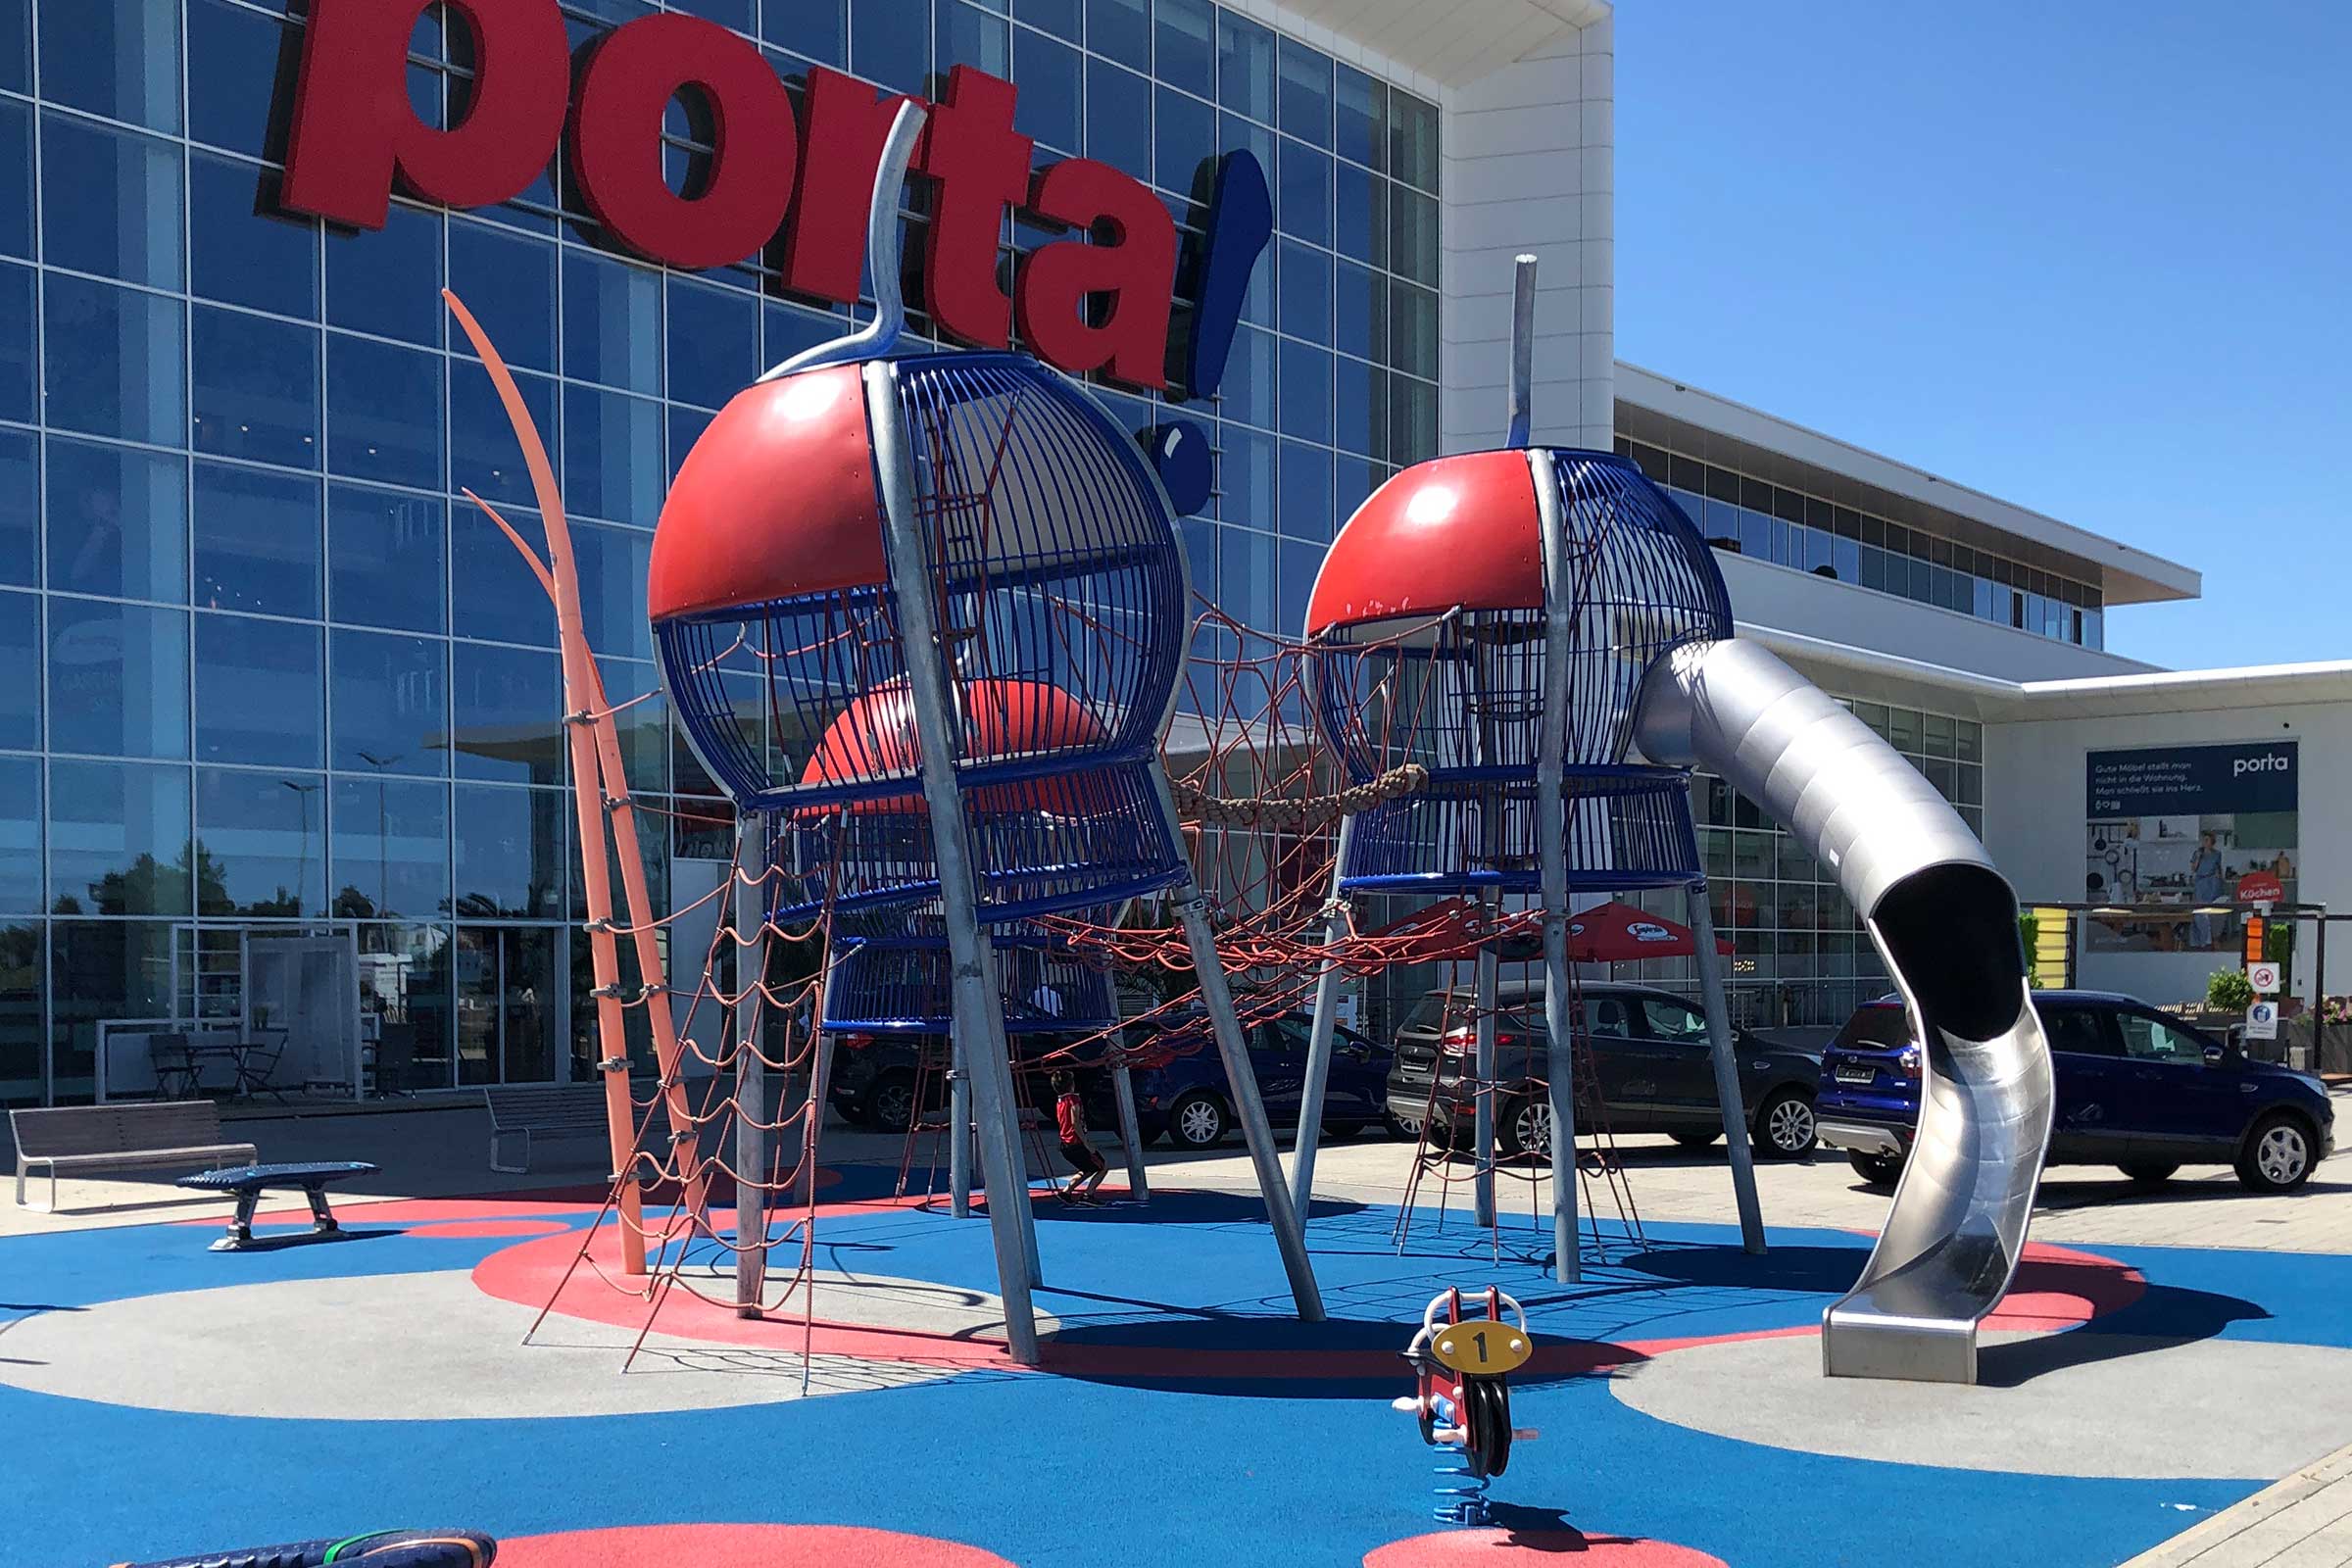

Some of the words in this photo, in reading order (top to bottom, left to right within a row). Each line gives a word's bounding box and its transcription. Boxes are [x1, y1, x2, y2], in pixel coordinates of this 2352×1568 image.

[2171, 761, 2192, 770] man
[2233, 753, 2289, 777] porta
[2119, 774, 2128, 784] in
[2095, 786, 2116, 796] Man
[2240, 887, 2280, 901] Küchen
[1472, 1331, 1488, 1363] 1
